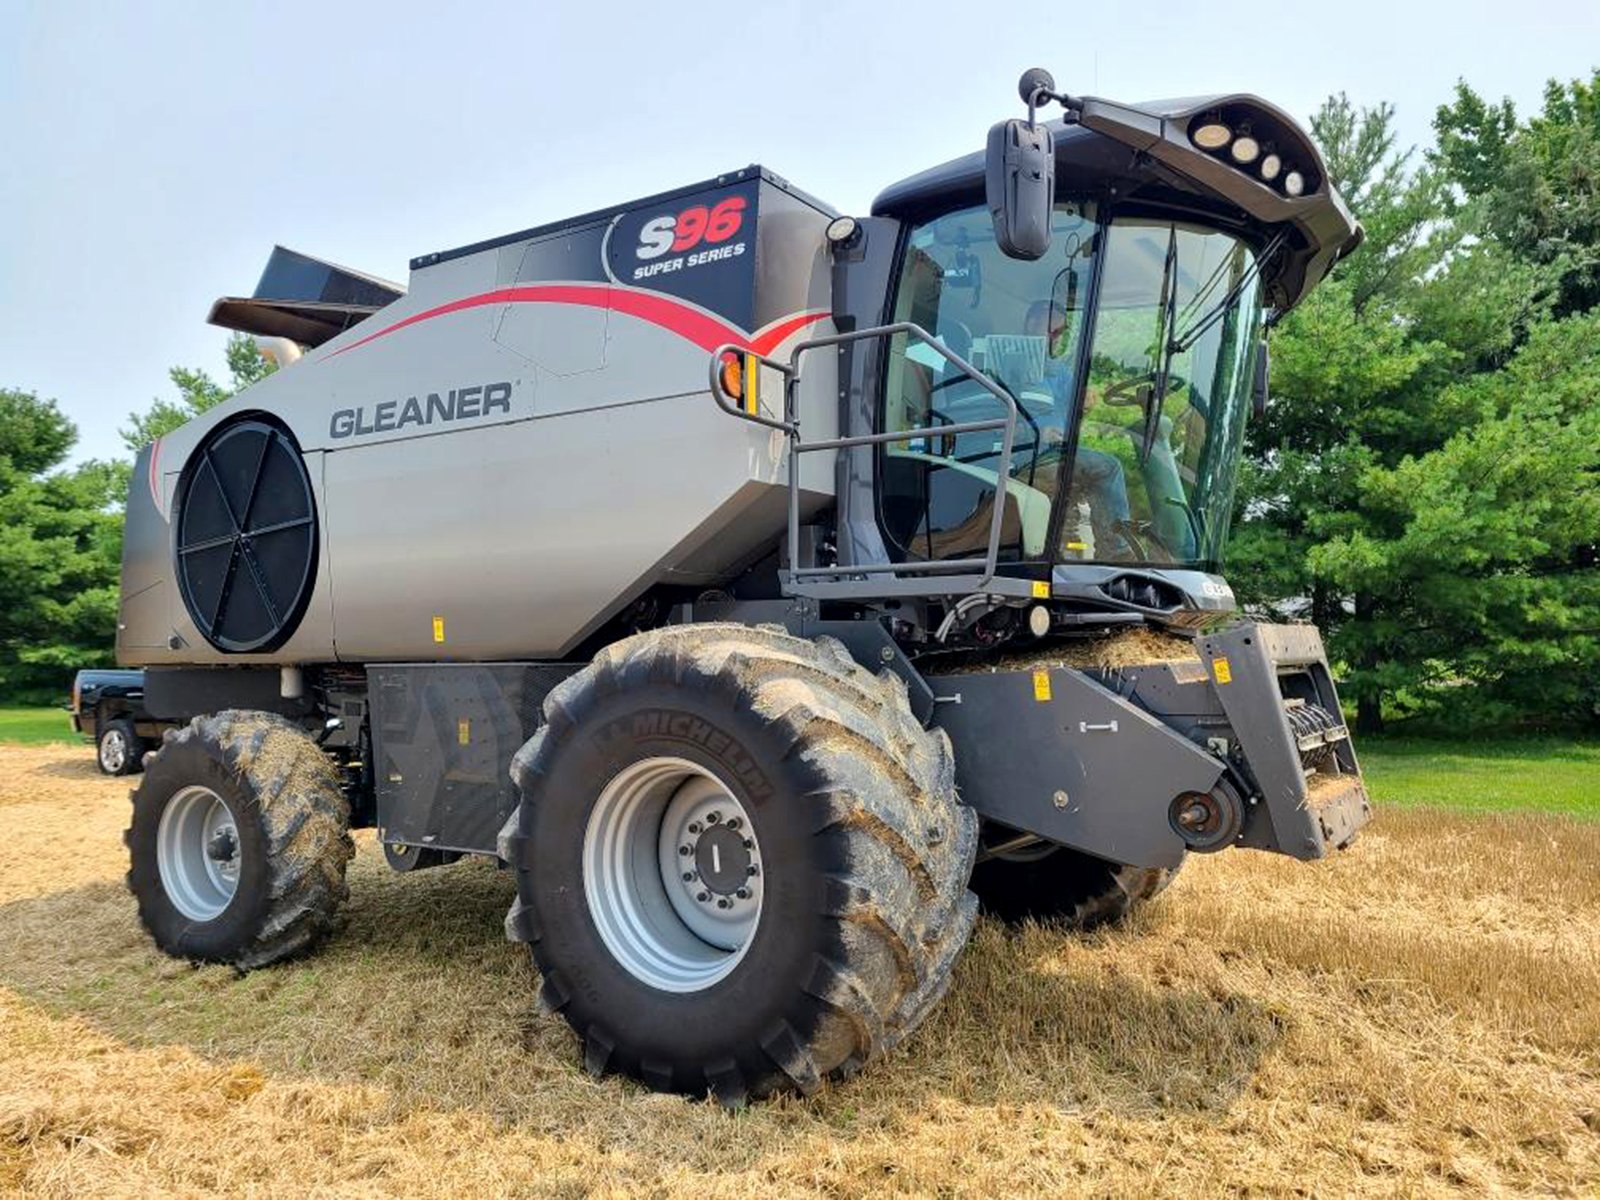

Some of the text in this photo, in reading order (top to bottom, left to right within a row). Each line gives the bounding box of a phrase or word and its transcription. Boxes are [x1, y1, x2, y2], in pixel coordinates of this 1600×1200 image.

[636, 197, 747, 260] S96
[633, 243, 746, 279] SUPER SERIES
[329, 382, 512, 439] GLEANER
[634, 711, 775, 801] MICHELIN
